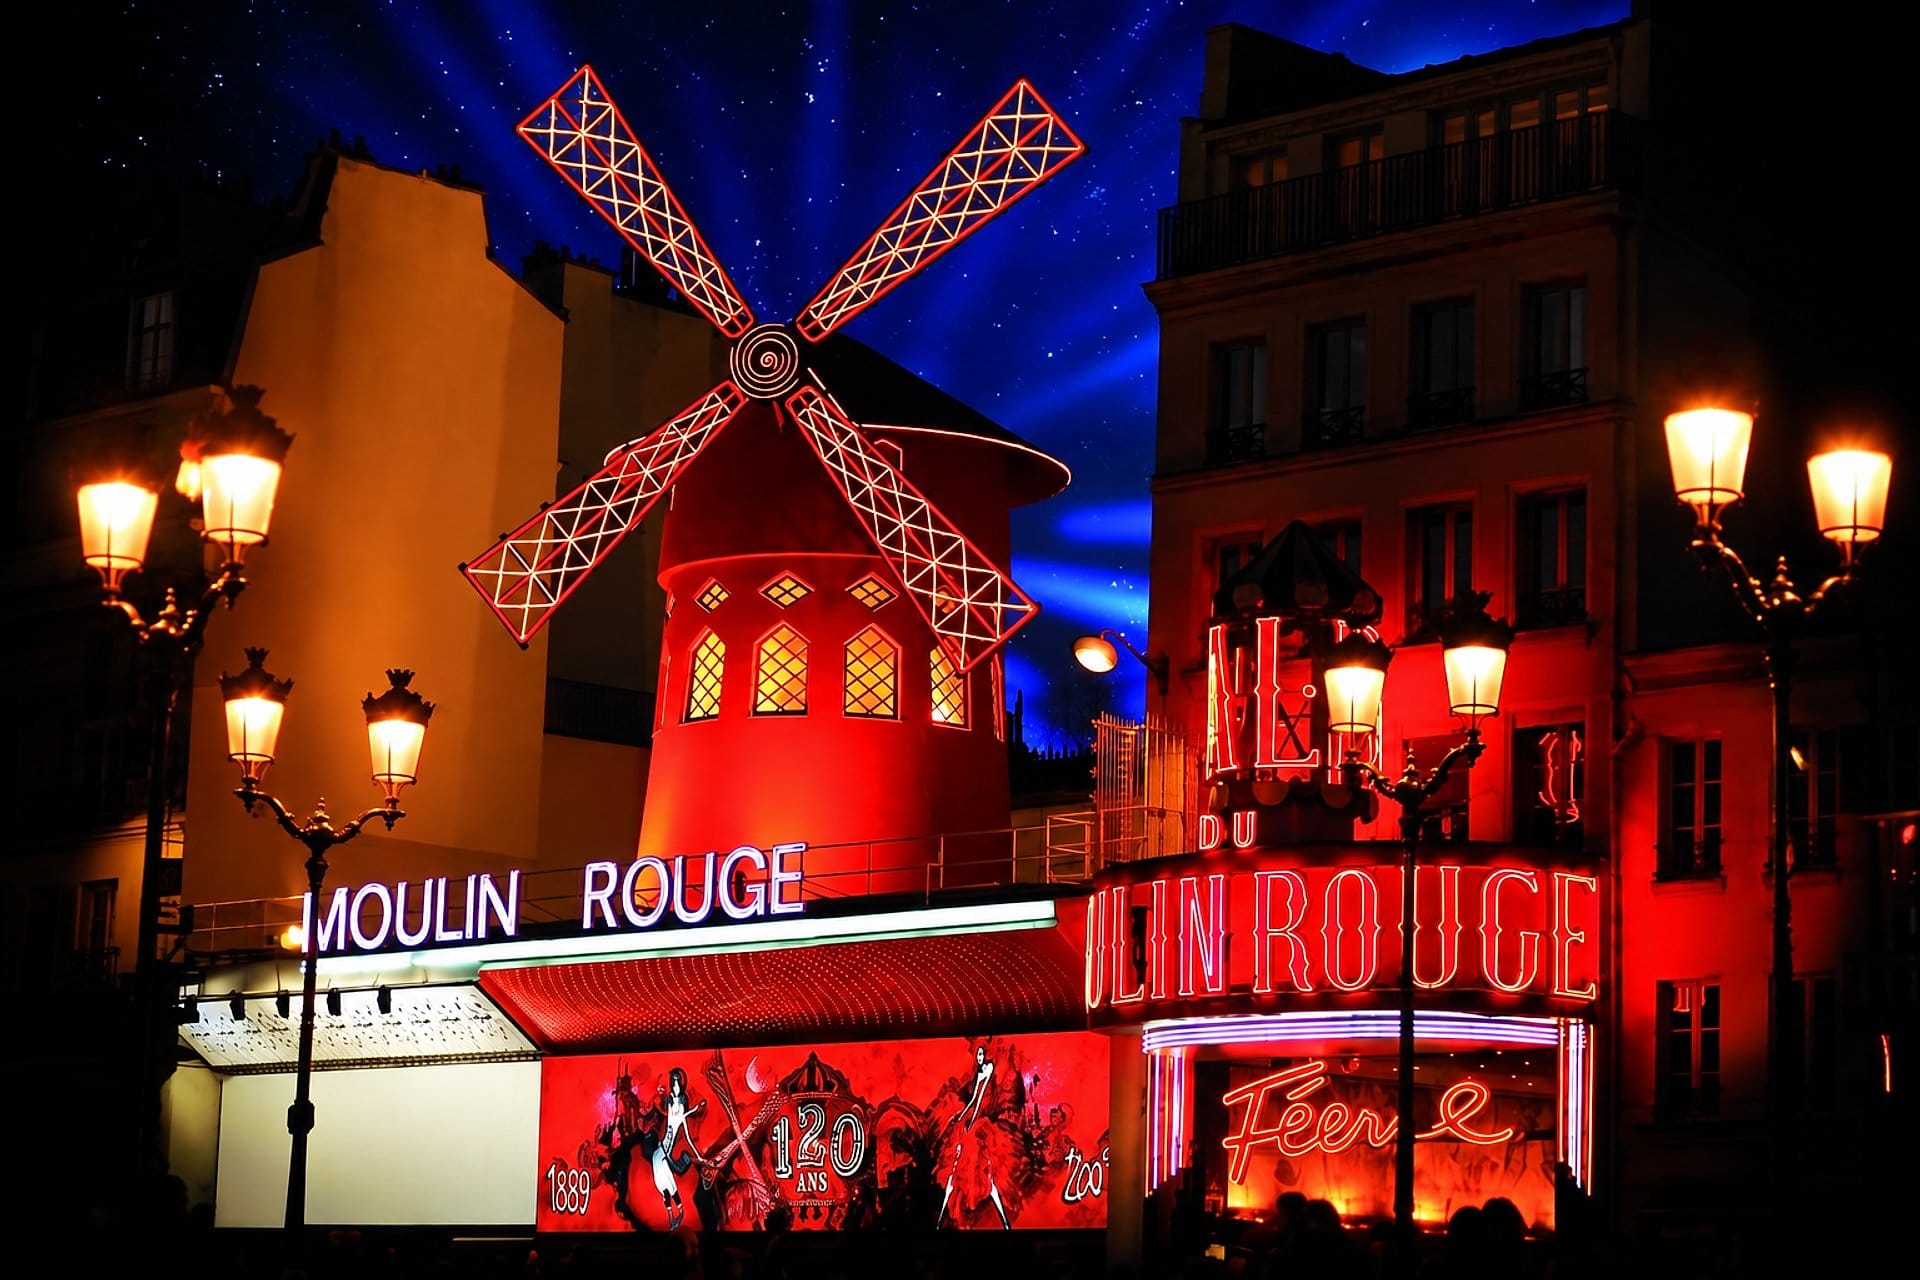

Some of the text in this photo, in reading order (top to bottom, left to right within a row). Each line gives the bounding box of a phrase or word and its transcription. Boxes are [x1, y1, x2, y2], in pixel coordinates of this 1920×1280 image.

[1199, 812, 1257, 850] DU
[302, 843, 806, 953] MOULIN ROUGE
[1253, 865, 1596, 1000] ROUGE
[772, 1104, 865, 1178] 120
[1223, 1060, 1513, 1184] Féere
[547, 1164, 591, 1215] 1889
[797, 1172, 828, 1192] ANS
